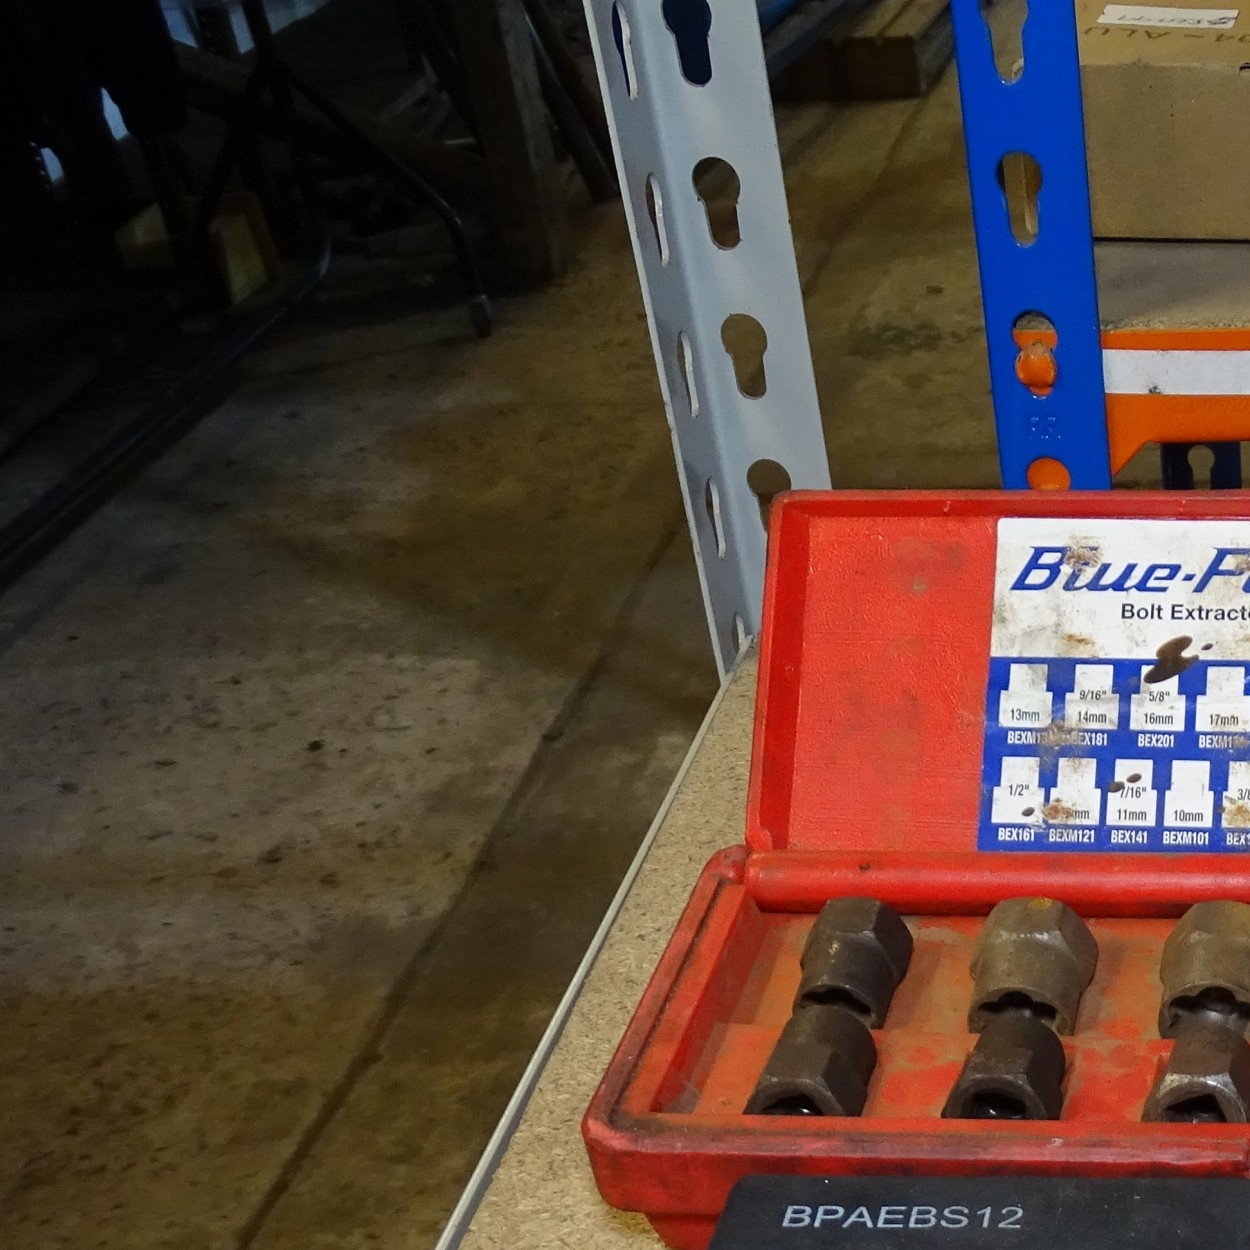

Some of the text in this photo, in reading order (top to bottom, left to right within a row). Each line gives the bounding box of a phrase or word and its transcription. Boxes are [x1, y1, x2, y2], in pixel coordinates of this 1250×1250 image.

[1121, 603, 1162, 620] Bolt
[1079, 690, 1107, 701] 9/16"
[1149, 691, 1170, 702] 5/8"
[1010, 709, 1040, 722] 13mm
[1077, 710, 1107, 723] 14mm
[1143, 712, 1174, 725] 16mm
[1209, 714, 1239, 726] 17mm
[1138, 733, 1175, 747] BEX201
[1009, 784, 1030, 796] 1/2"
[1119, 787, 1147, 799] 7/16"
[1117, 808, 1147, 821] 11mm
[1173, 810, 1204, 822] 10mm
[998, 828, 1035, 841] BEX161
[1049, 829, 1095, 843] BEXM121
[1110, 830, 1148, 844] BEX141
[1163, 831, 1209, 845] BEXM101
[781, 1205, 1025, 1229] BPAEBS12
